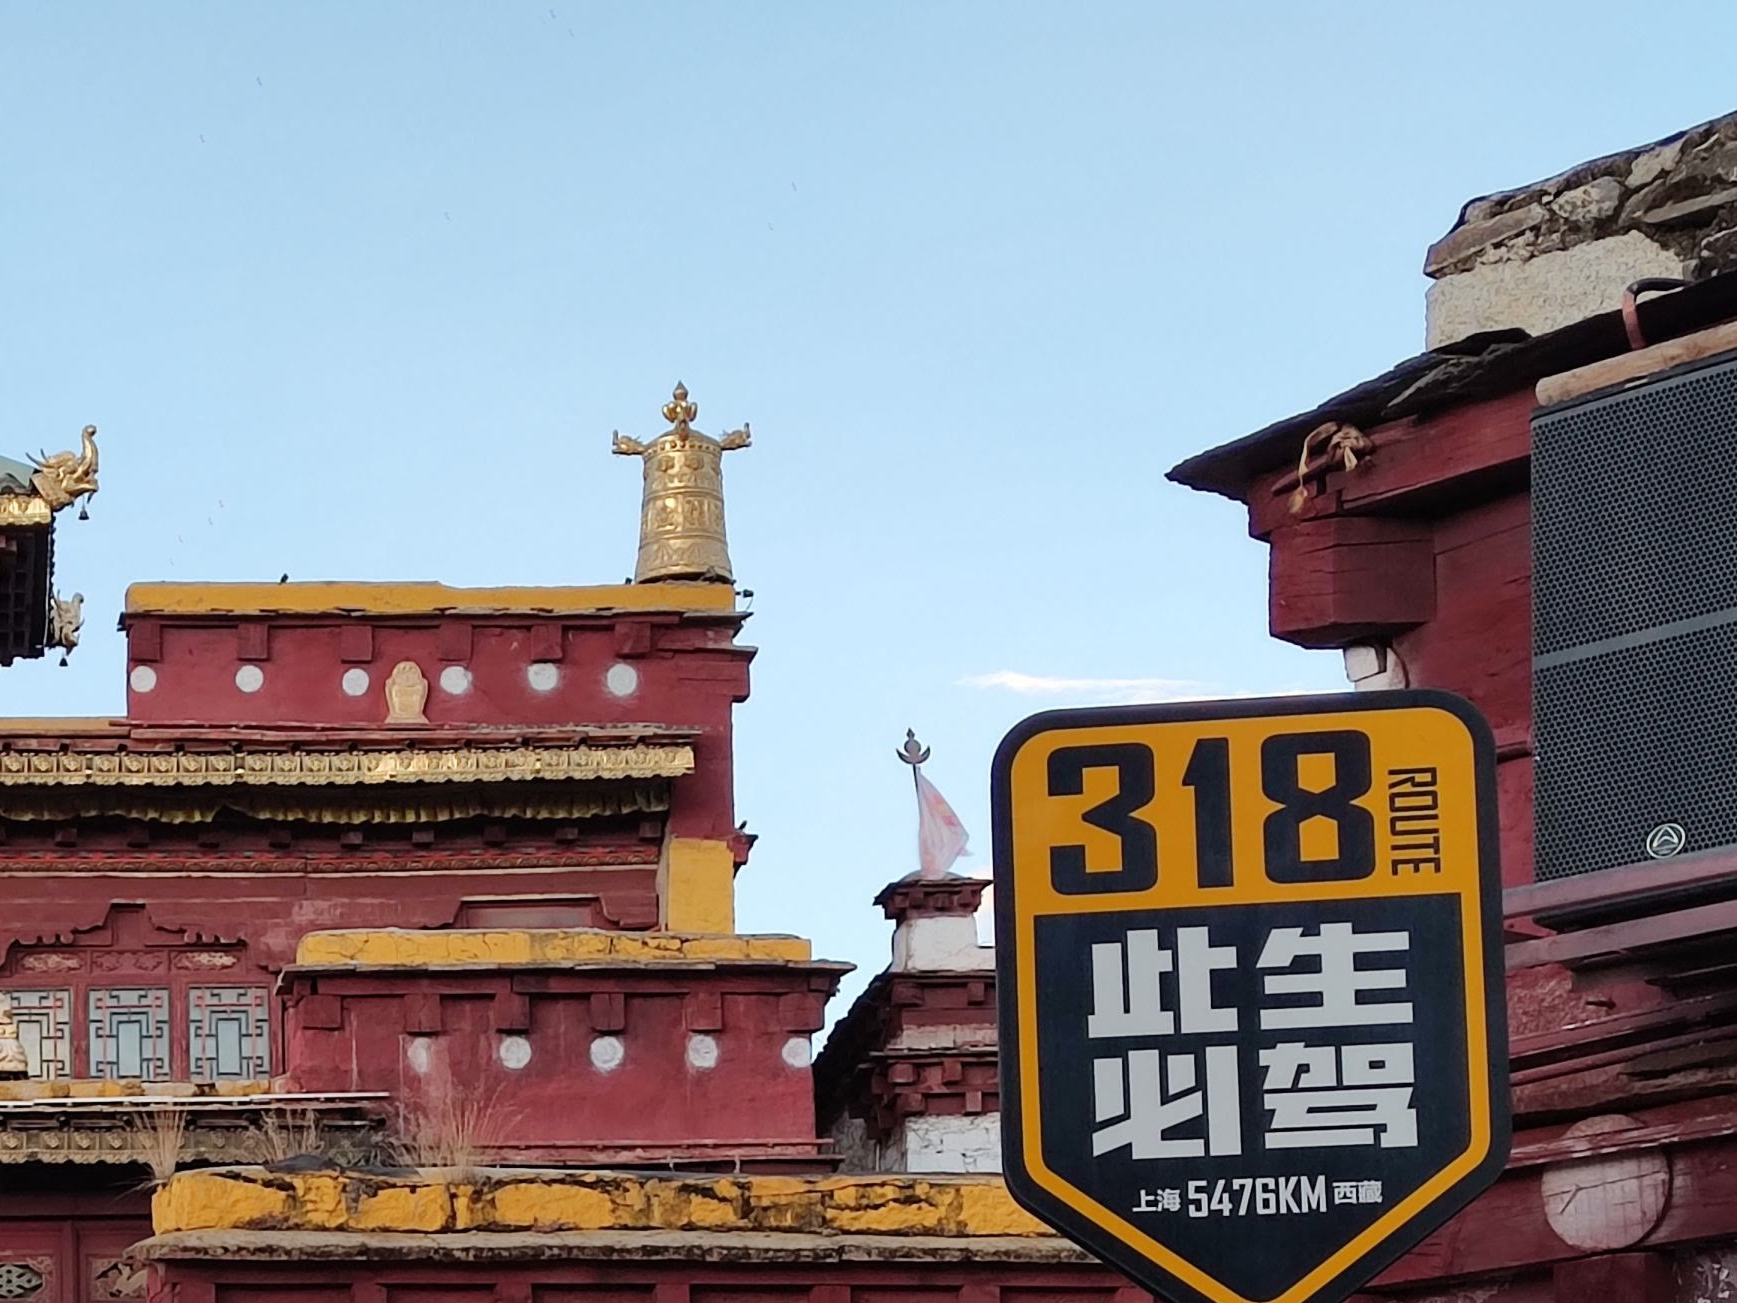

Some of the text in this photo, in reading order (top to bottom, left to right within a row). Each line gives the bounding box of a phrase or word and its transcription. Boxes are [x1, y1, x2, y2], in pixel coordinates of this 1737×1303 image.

[1046, 729, 1376, 895] 318
[1387, 766, 1441, 876] ROUTE
[1087, 922, 1414, 1038] 此生
[1092, 1042, 1418, 1160] 必驾
[1132, 1175, 1383, 1218] 上海 5476KM 西藏
